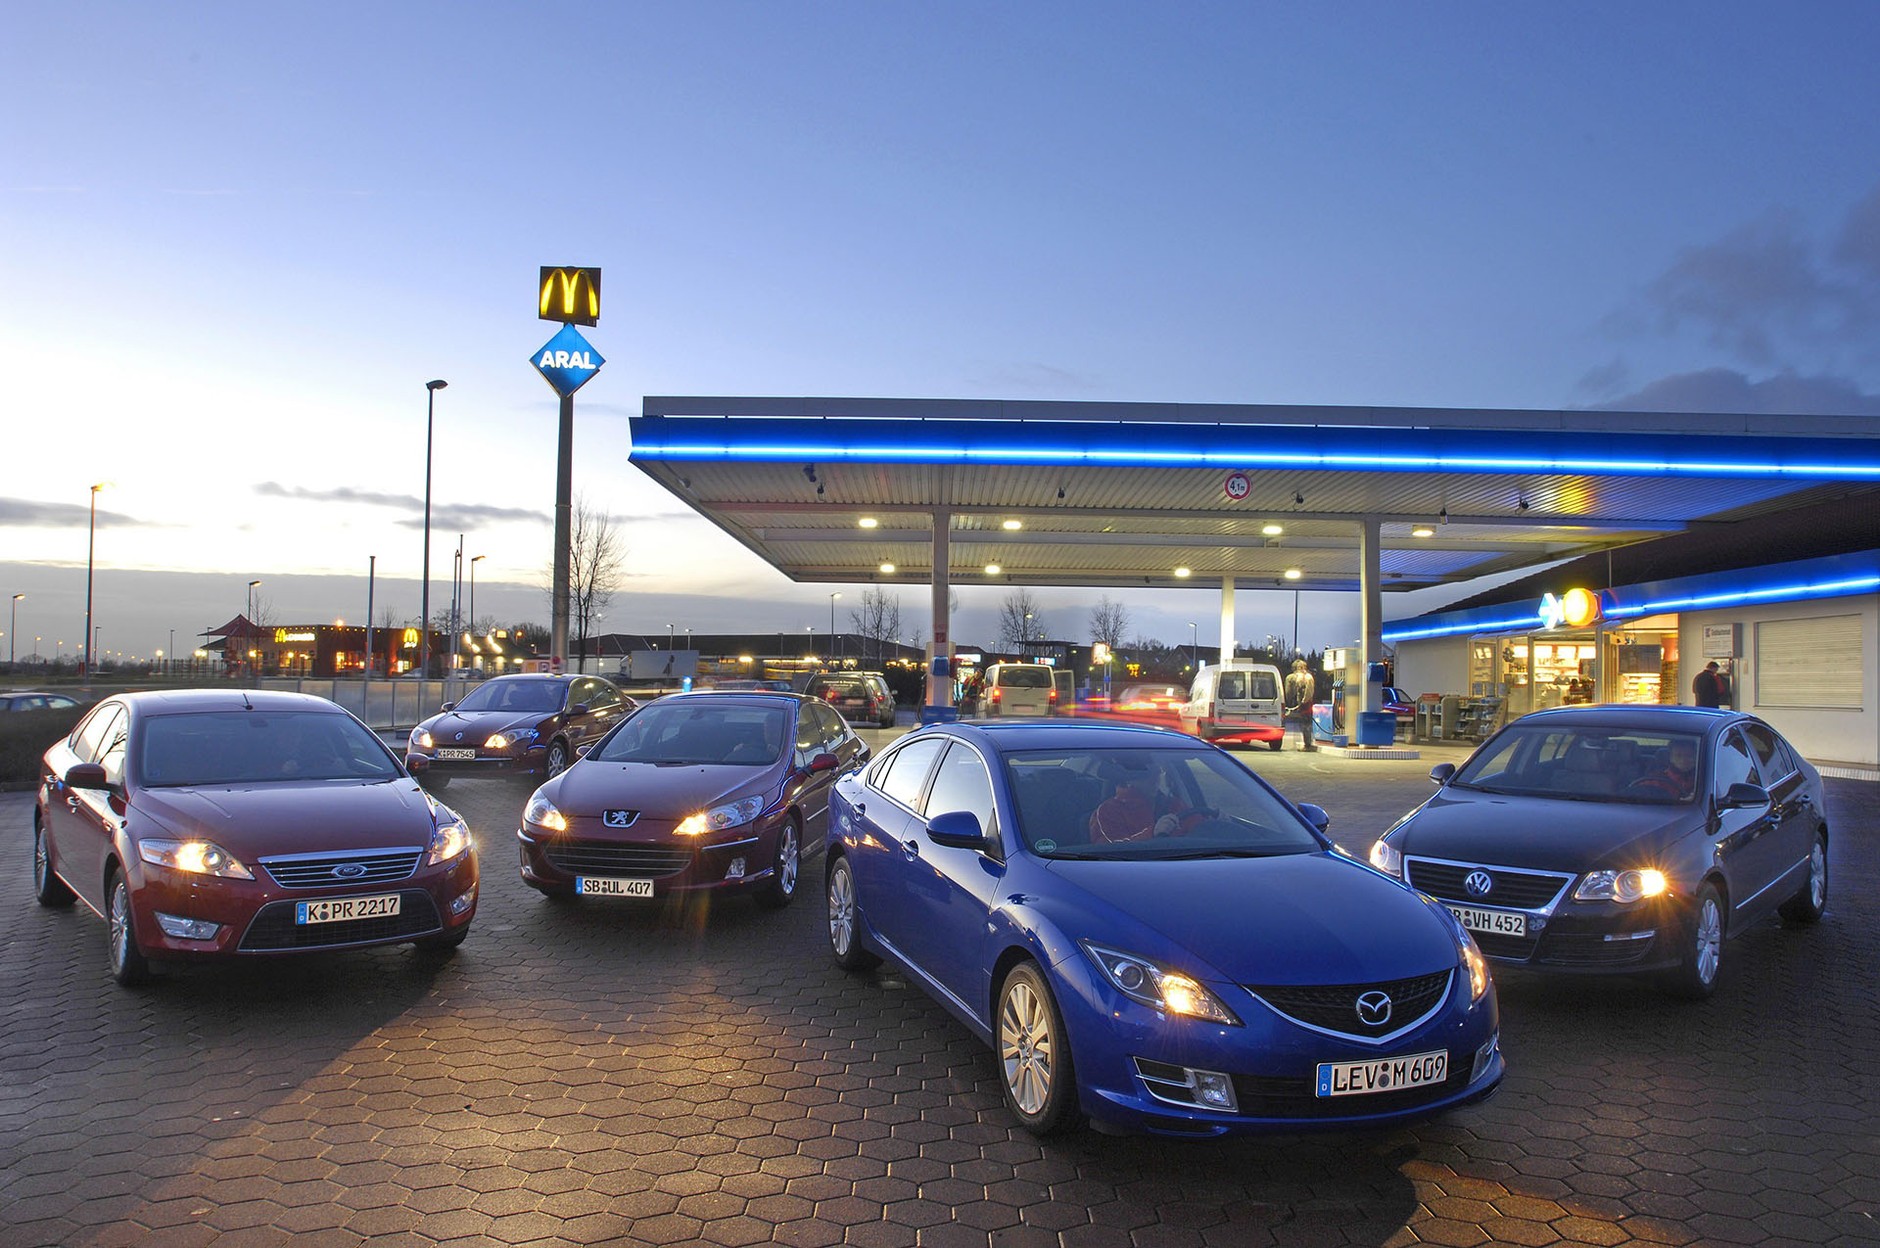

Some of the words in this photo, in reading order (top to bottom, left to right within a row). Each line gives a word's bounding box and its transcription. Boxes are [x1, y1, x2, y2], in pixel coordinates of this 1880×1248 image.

[540, 350, 596, 370] ARAL
[584, 880, 600, 893] SB
[608, 881, 624, 894] UL
[627, 882, 651, 895] 407
[308, 904, 319, 921] K
[332, 902, 353, 919] PR
[357, 898, 399, 917] 2217
[1472, 911, 1491, 930] VH
[1495, 914, 1523, 934] 452
[1333, 1064, 1378, 1092] LEV
[1393, 1061, 1406, 1086] M
[1410, 1055, 1446, 1083] 609
